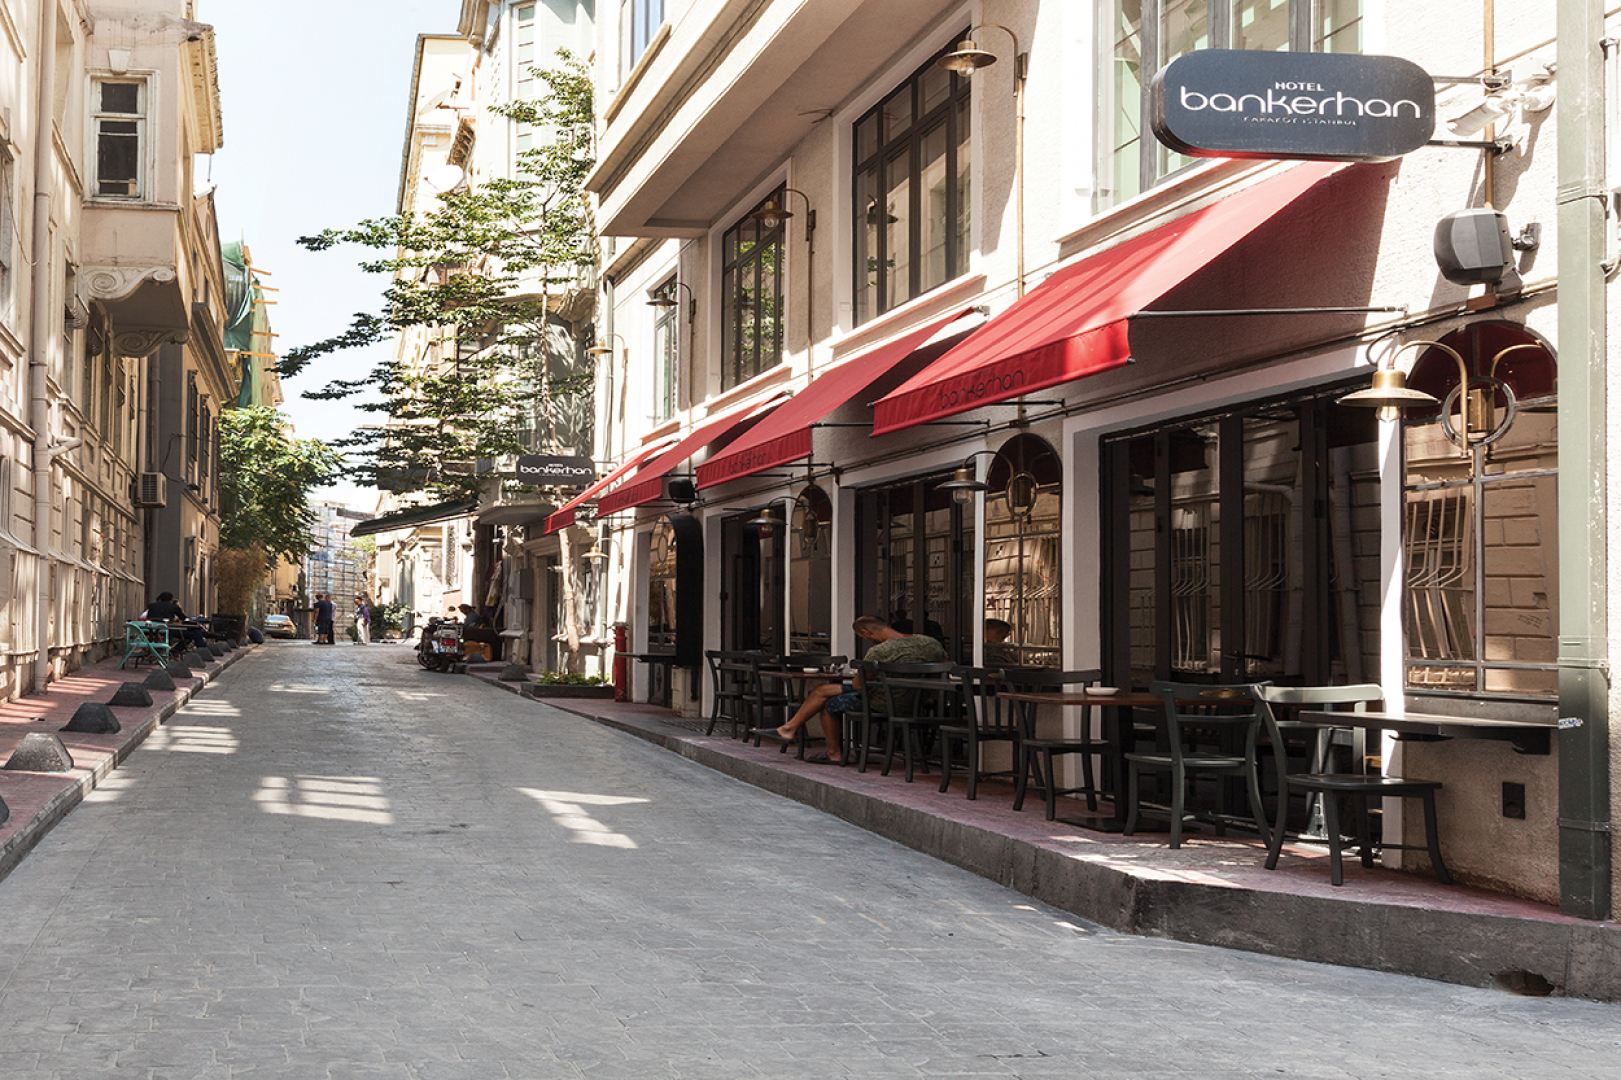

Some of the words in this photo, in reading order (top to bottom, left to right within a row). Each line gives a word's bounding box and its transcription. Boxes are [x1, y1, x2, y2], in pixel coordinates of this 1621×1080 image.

[1179, 85, 1421, 119] bankerhan
[1275, 81, 1325, 92] HOTEL
[939, 370, 1024, 409] bankerhan
